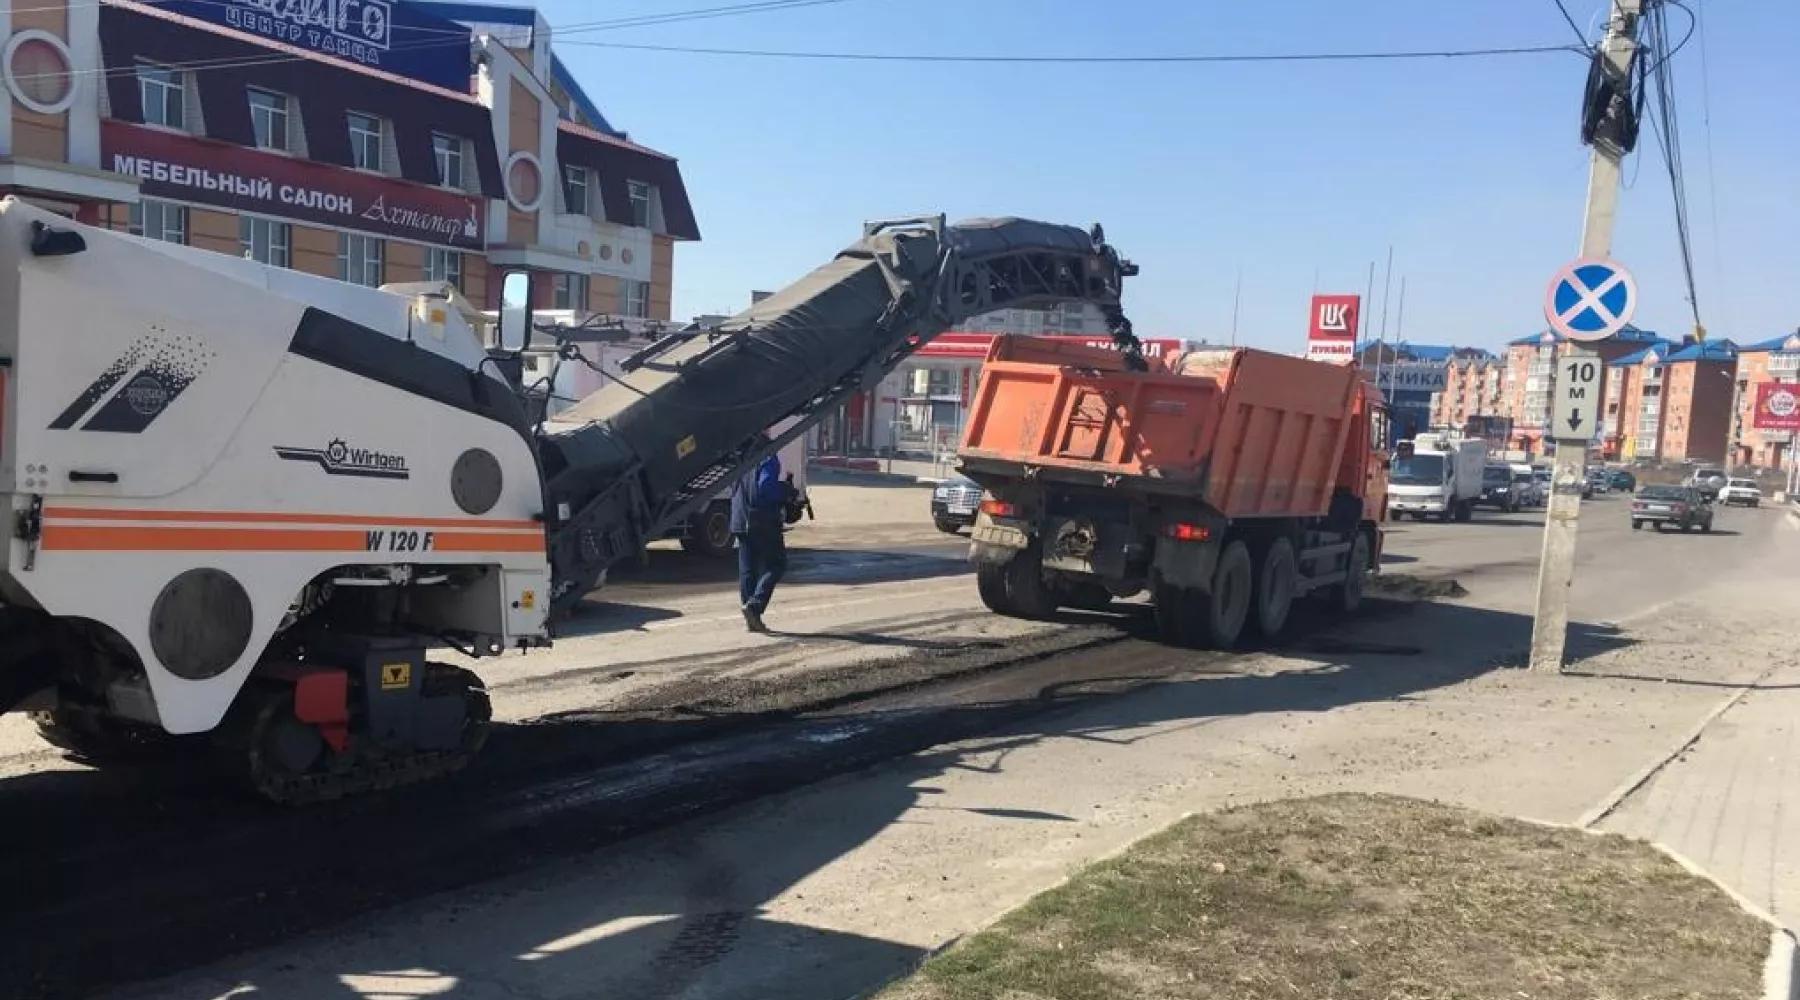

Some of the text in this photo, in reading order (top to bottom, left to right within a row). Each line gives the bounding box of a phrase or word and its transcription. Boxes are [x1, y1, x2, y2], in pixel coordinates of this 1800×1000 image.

[225, 5, 380, 65] ЦЕНТР ТАНЦА
[232, 0, 386, 40] ДИГО
[113, 153, 273, 200] МЕБЕЛЬНЫЙ
[279, 185, 354, 215] САЛОН
[1566, 362, 1595, 383] 10
[350, 449, 405, 468] Wirtgen
[365, 531, 434, 552] W 120 F
